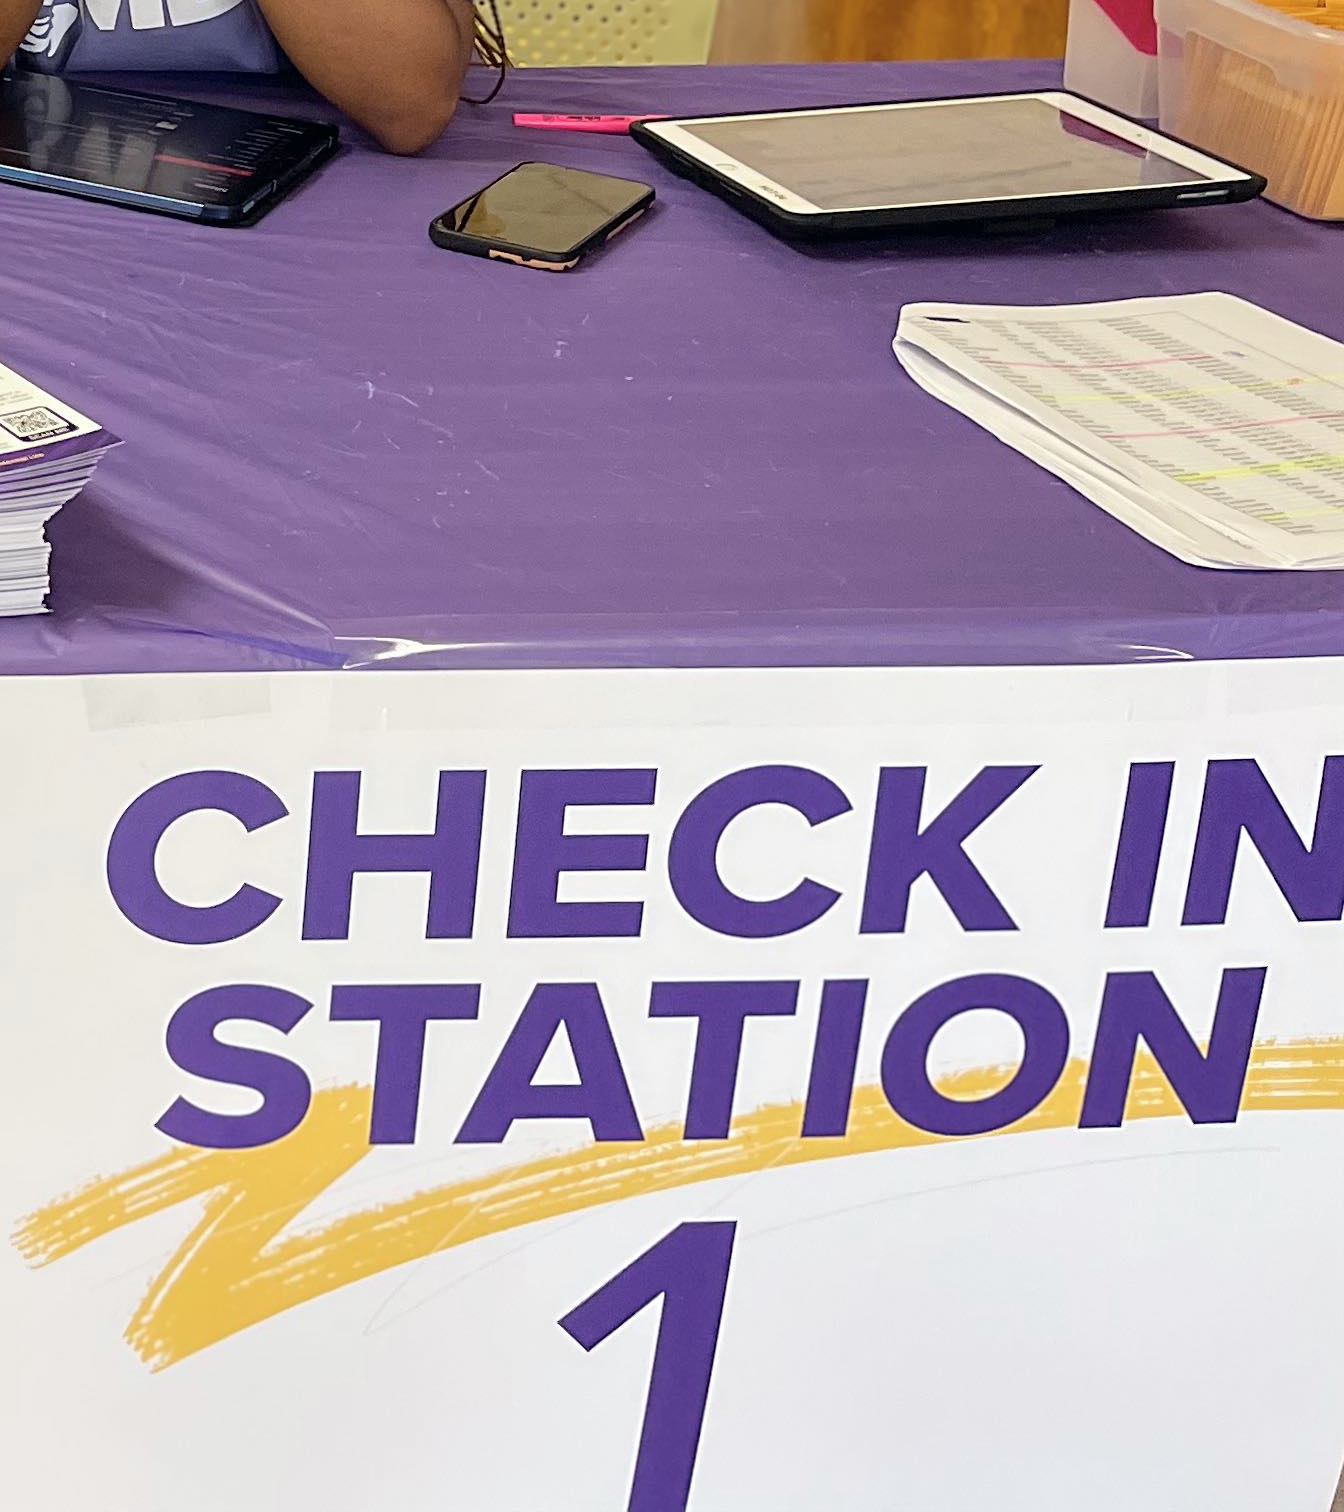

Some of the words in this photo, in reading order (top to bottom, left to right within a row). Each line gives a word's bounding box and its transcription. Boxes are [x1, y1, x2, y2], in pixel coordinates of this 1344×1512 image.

[106, 763, 1043, 946] CHECK
[1102, 753, 1344, 930] IN
[153, 964, 1270, 1151] STATION
[556, 1218, 739, 1512] 1
